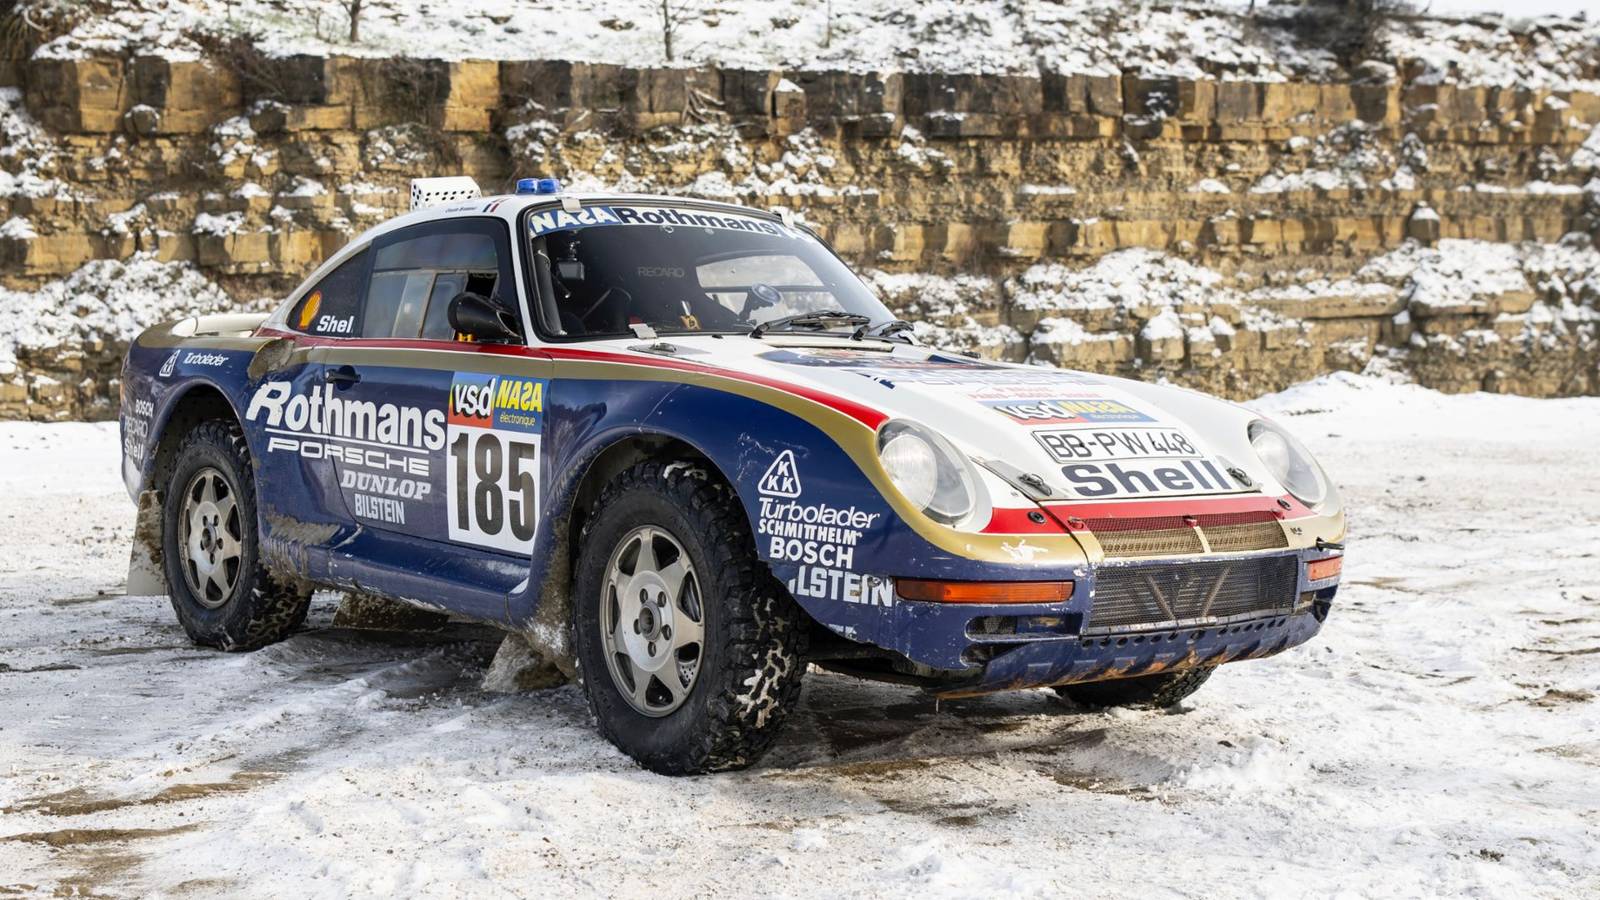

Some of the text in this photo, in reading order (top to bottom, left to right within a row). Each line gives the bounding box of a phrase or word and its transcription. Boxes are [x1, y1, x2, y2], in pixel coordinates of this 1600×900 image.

[611, 207, 778, 235] Rothmans
[638, 266, 685, 278] RECARO
[316, 315, 355, 334] Shel
[135, 399, 154, 418] BOSCH
[453, 378, 542, 418] vsd NASA
[994, 401, 1076, 420] vsd
[245, 381, 446, 450] Rothmans
[500, 413, 536, 428] électronique
[124, 437, 144, 460] Shell
[267, 437, 430, 477] PORSCHE
[1041, 432, 1197, 458] BB-PW 448
[340, 470, 432, 500] DUNLOP
[451, 432, 536, 542] 185
[1061, 460, 1233, 497] Shell
[354, 493, 406, 524] BILSTEIN
[758, 497, 881, 529] Turbolader
[758, 518, 862, 546] SCHMITTHELM
[769, 536, 854, 569] BOSCH
[788, 565, 893, 607] ILSTEIN
